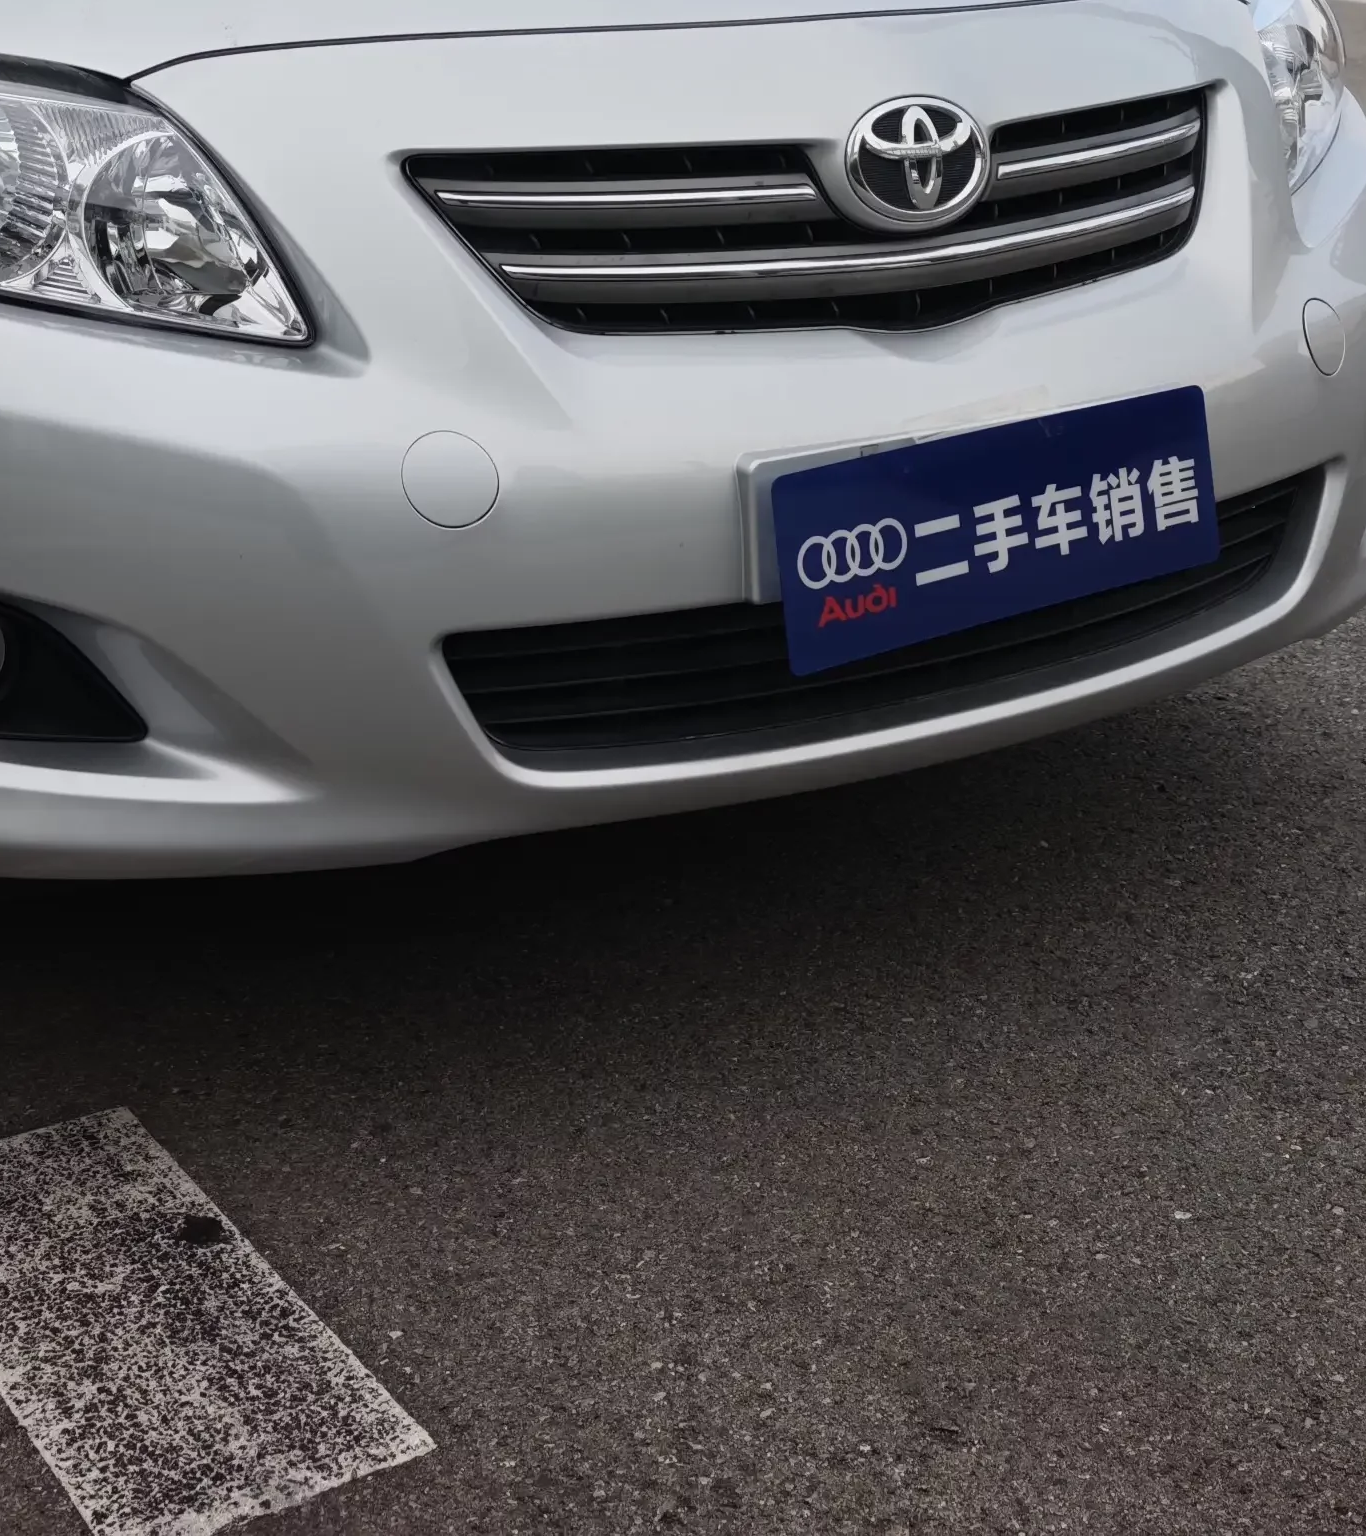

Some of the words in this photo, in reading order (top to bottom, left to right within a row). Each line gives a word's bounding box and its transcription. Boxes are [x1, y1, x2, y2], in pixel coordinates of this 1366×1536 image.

[914, 456, 1200, 586] 二手车销售
[818, 583, 898, 628] Audi
